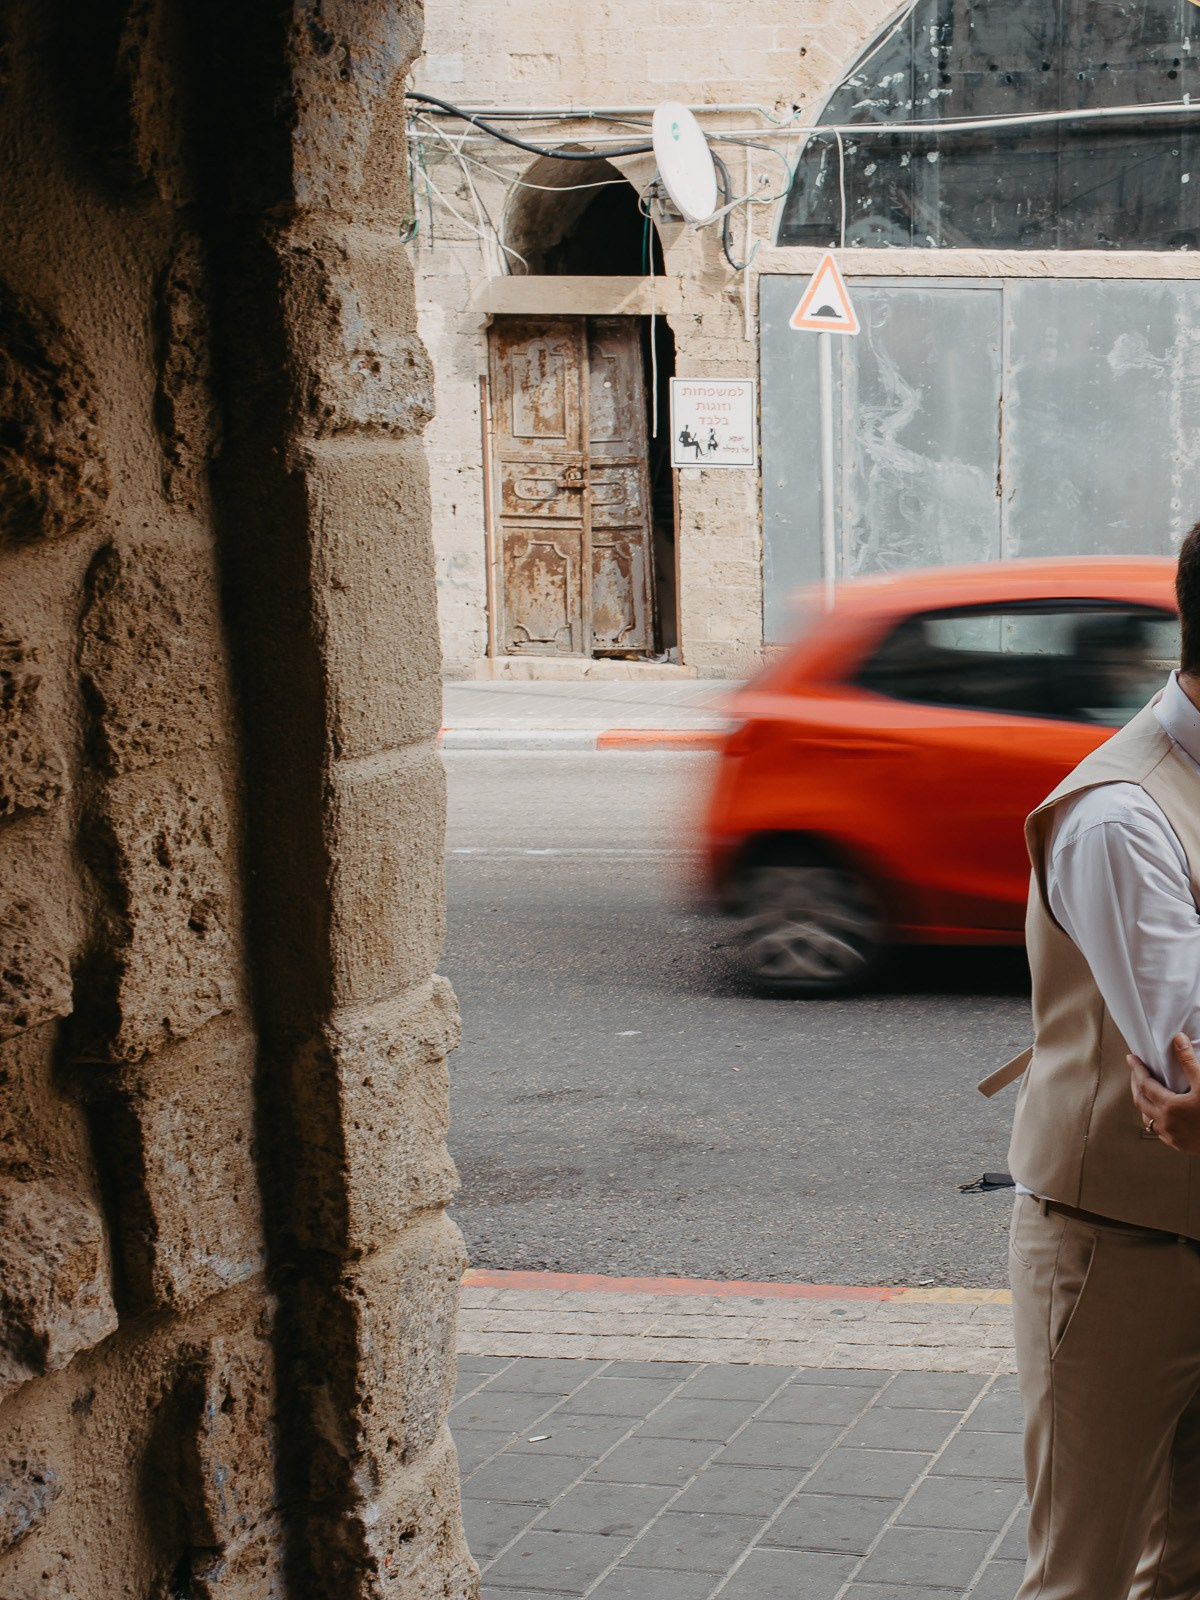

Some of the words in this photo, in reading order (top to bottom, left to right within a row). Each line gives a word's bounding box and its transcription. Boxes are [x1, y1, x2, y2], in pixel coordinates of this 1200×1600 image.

[682, 386, 744, 397] למשפחות
[696, 402, 731, 411] וזוגות
[699, 415, 729, 426] בלבד
